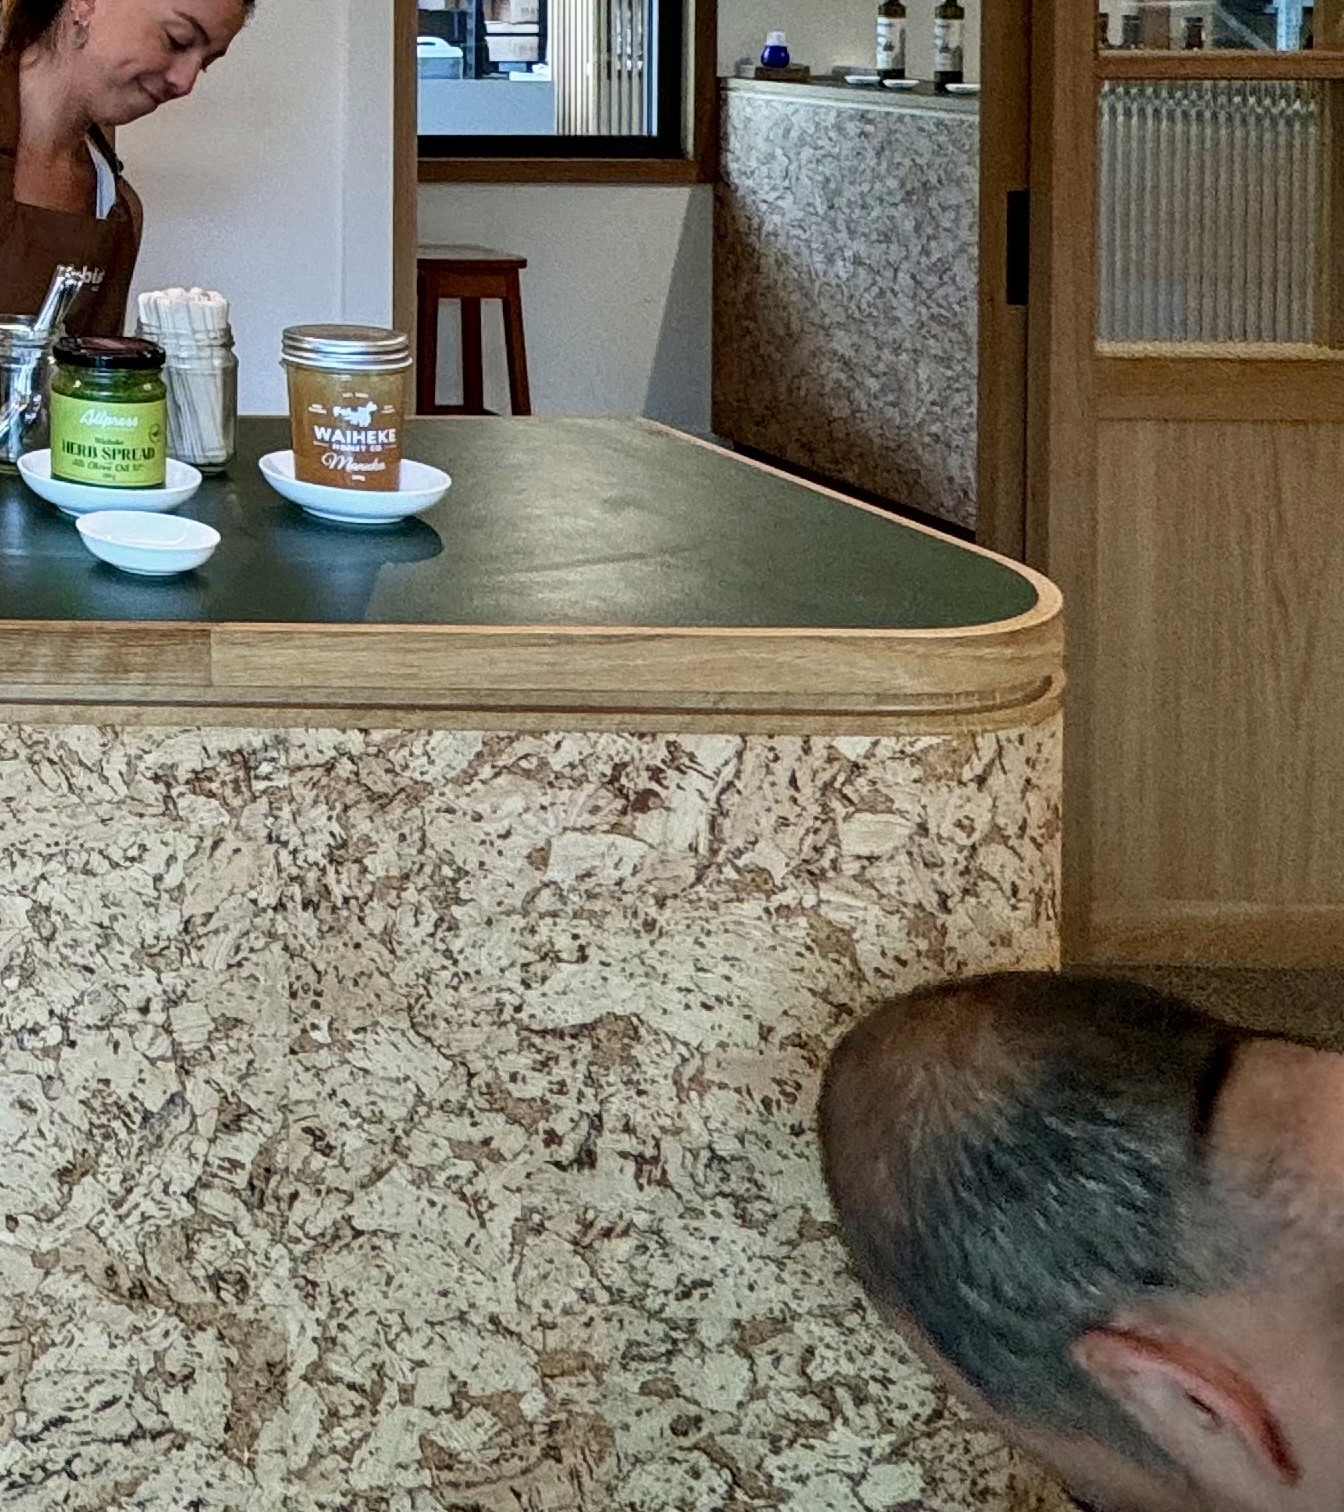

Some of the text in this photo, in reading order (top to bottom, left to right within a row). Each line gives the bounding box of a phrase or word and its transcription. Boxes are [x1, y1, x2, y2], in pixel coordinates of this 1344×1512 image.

[79, 408, 138, 429] Allpress
[314, 425, 396, 445] WAIHEKE
[62, 439, 155, 461] HERB SPREAD
